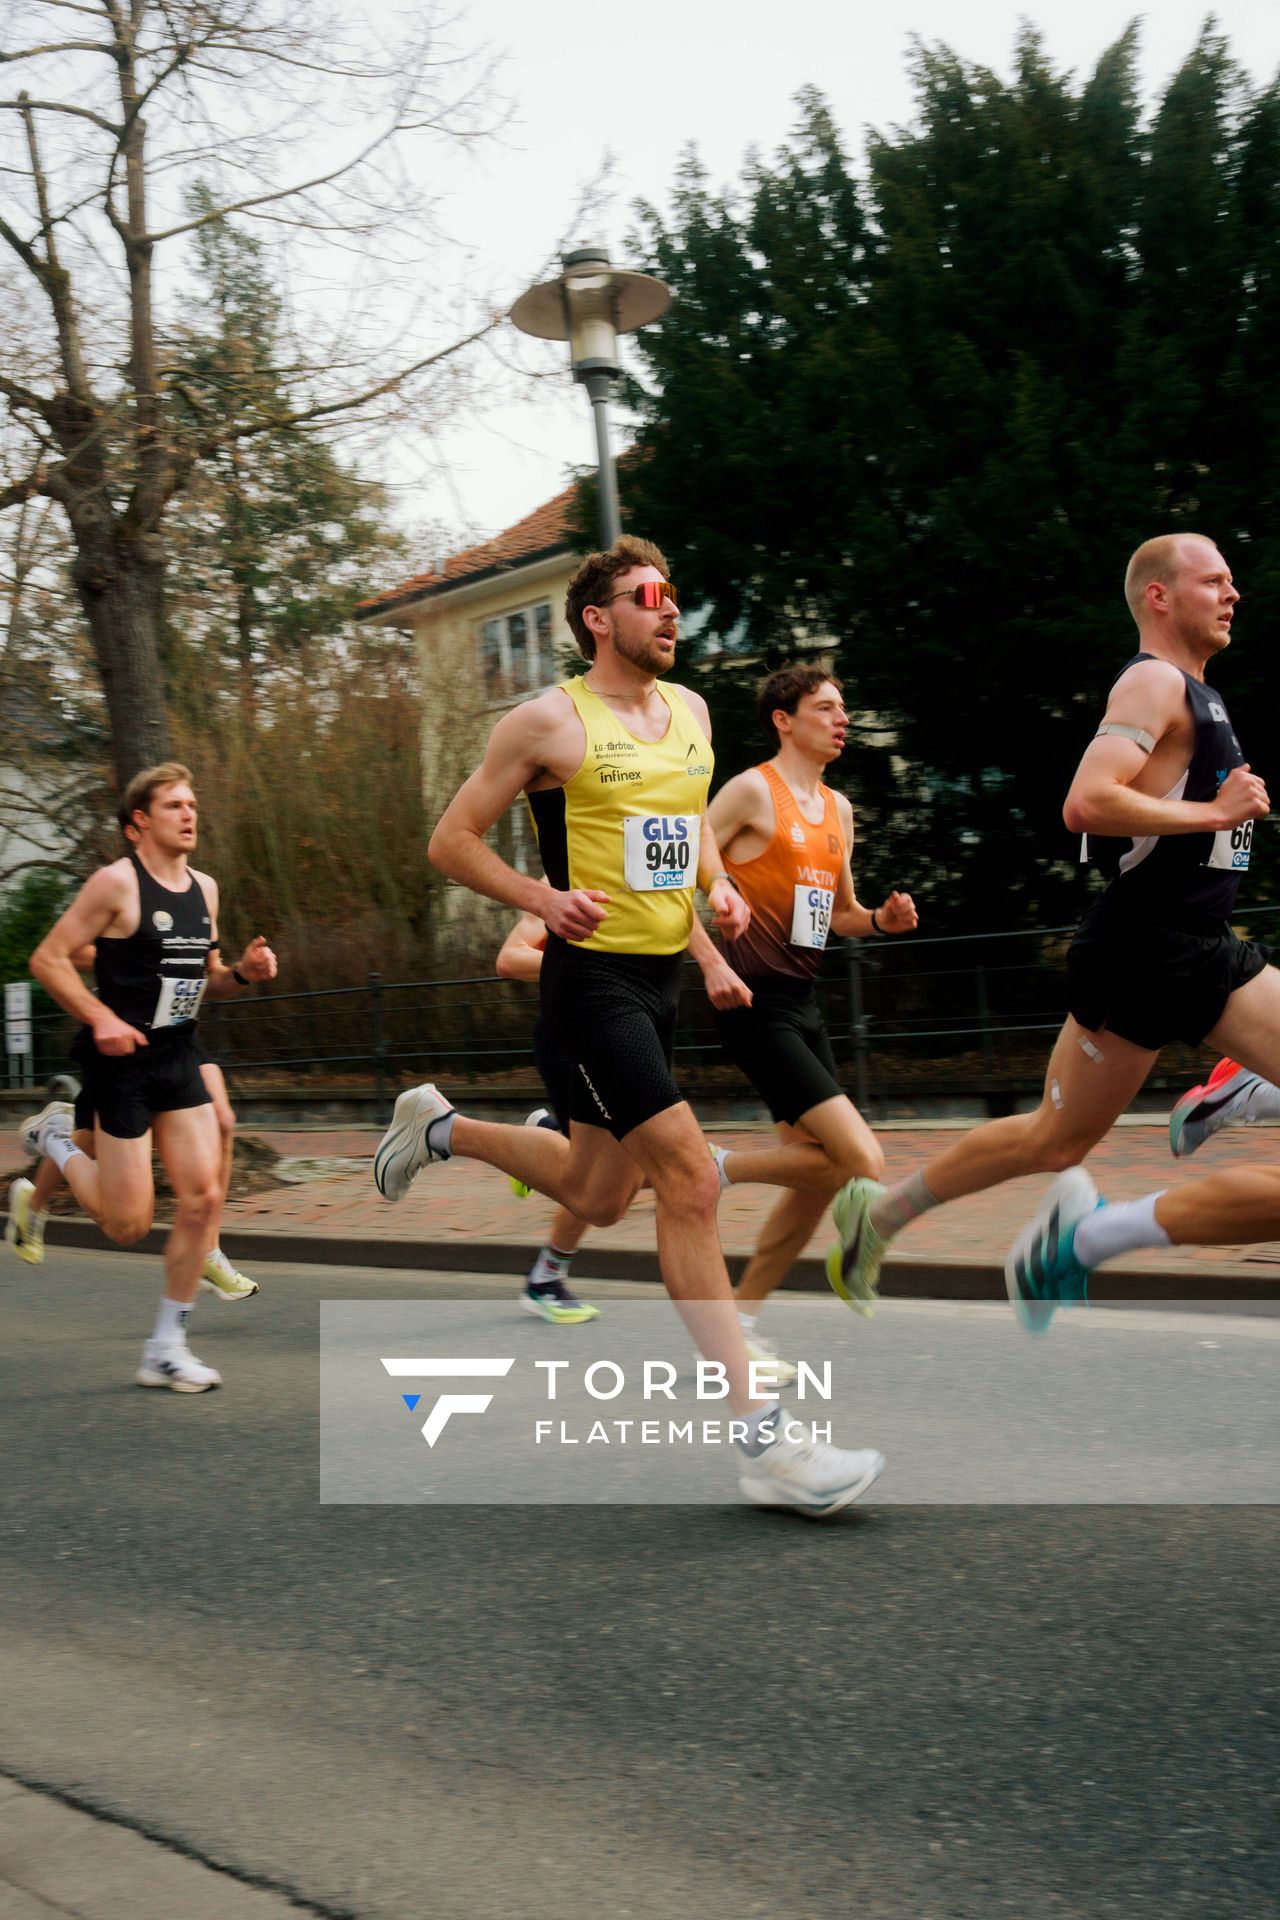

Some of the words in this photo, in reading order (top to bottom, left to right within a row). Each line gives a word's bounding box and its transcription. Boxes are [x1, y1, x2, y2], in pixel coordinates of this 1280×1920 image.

[600, 770, 642, 783] infinex
[642, 817, 688, 842] GLS
[645, 841, 690, 871] 940
[808, 889, 831, 911] GLS
